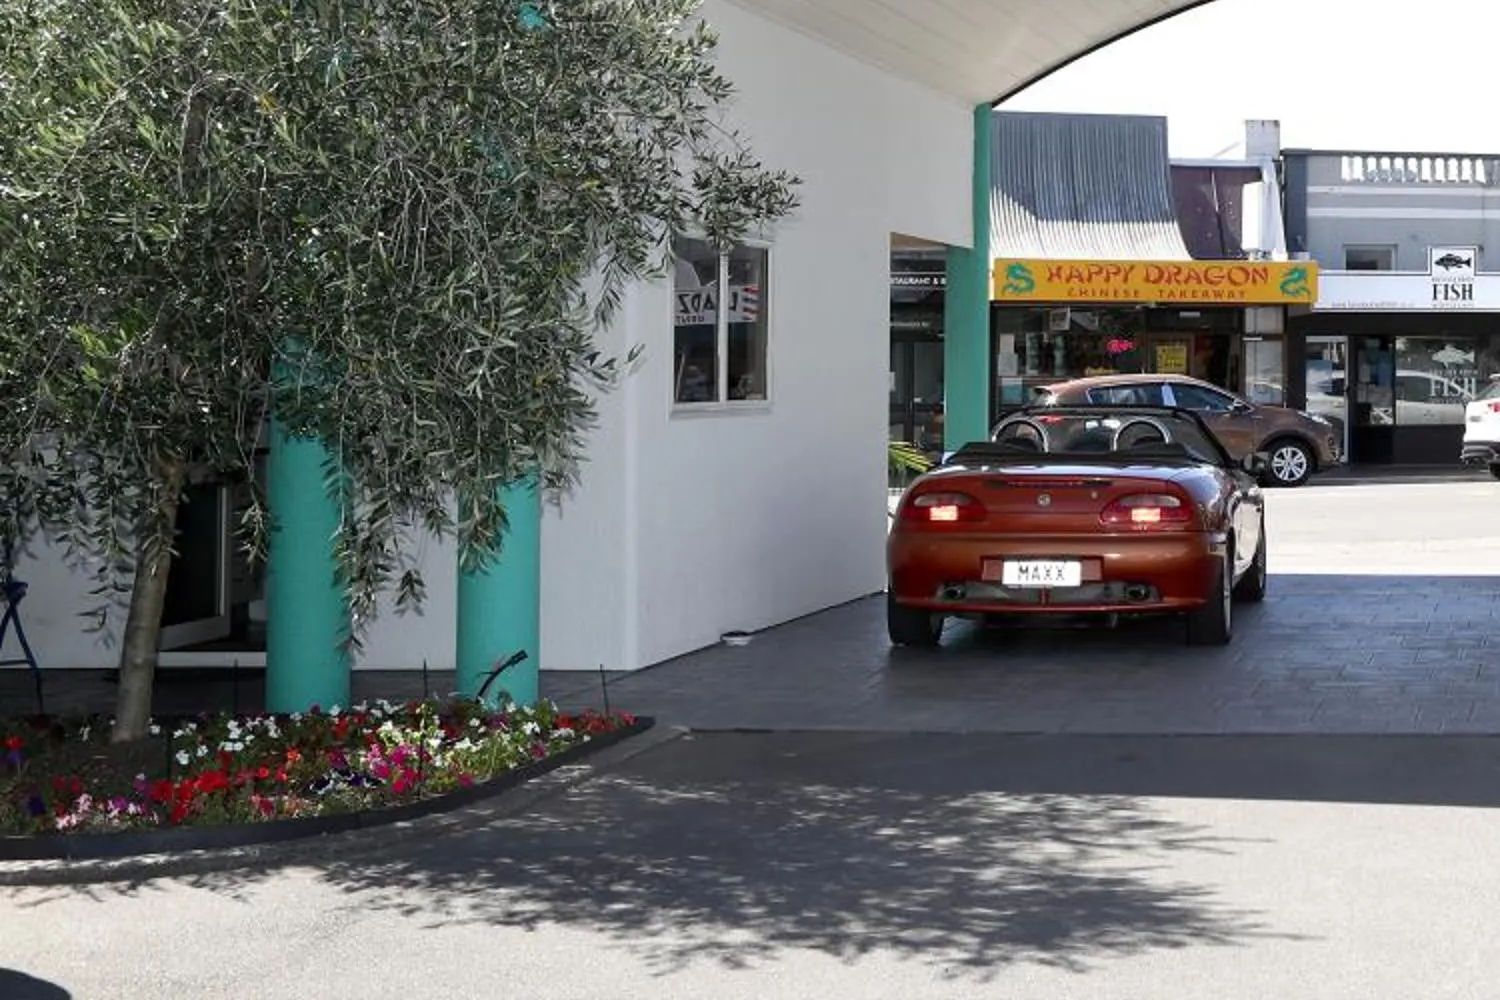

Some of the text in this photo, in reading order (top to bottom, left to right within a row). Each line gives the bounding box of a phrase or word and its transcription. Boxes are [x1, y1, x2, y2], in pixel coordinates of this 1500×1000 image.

[1046, 264, 1269, 286] HAPPY DRAGON
[1067, 287, 1246, 299] CHINESE TAKEAWAY
[1432, 283, 1473, 301] FISH
[1018, 564, 1065, 581] MAXX
